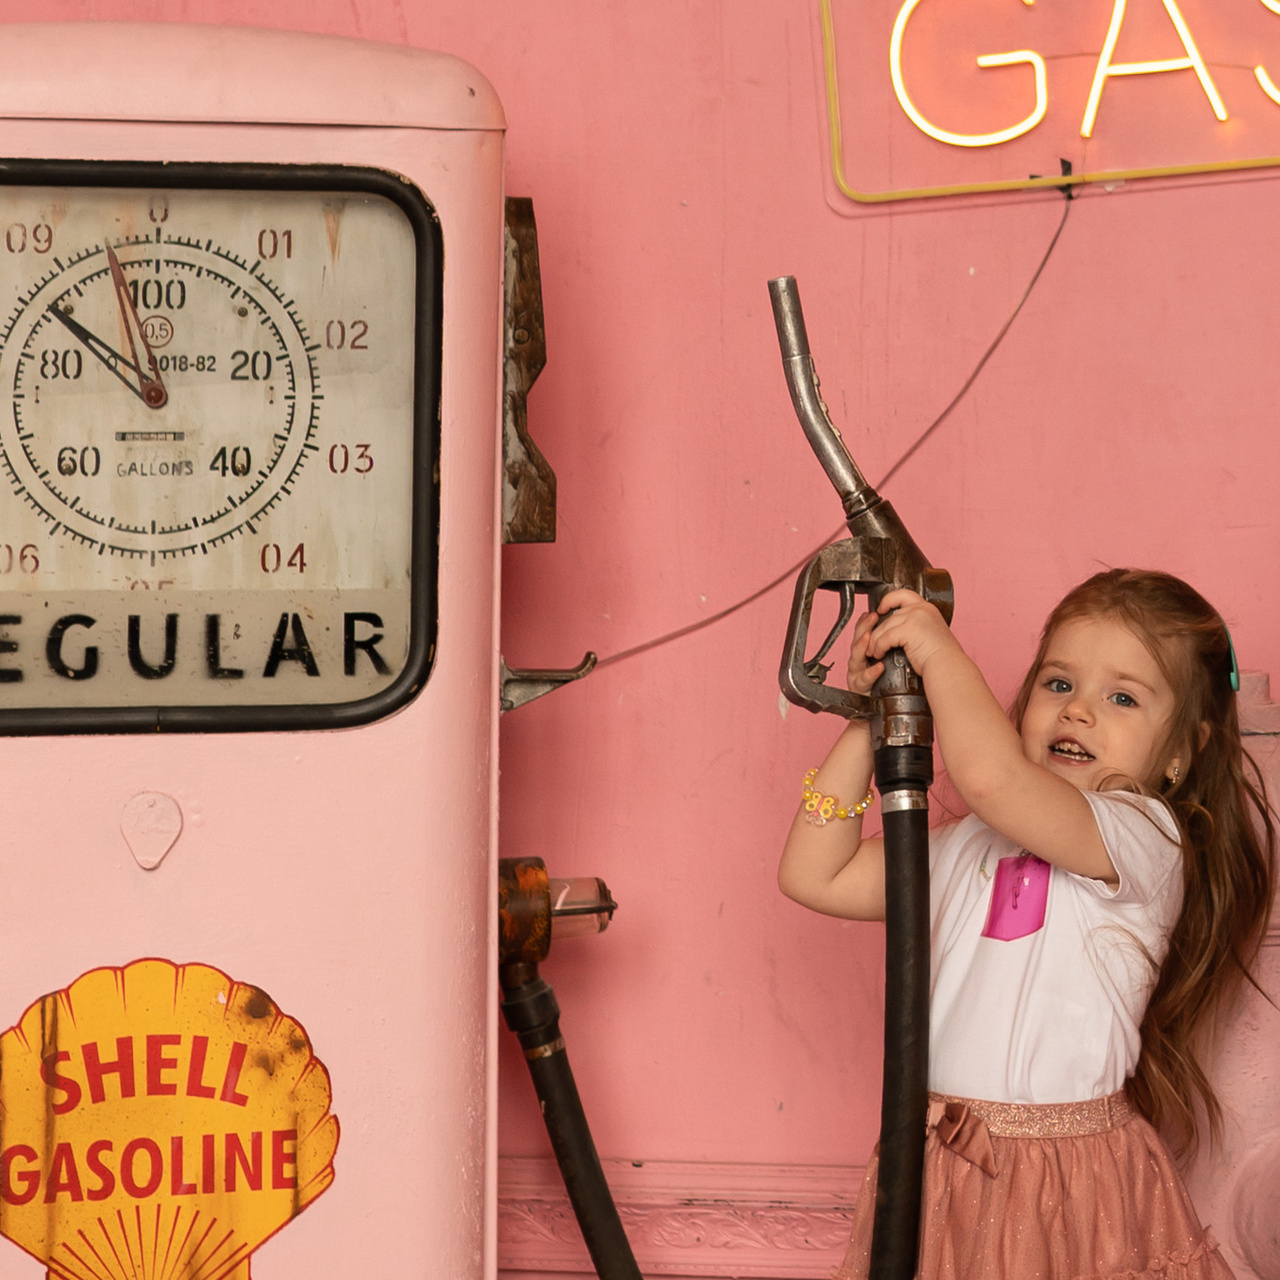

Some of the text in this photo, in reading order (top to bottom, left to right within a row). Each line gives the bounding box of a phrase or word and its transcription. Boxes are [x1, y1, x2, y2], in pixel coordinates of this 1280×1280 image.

[5, 223, 53, 254] 09
[257, 229, 294, 259] 01
[129, 279, 186, 310] 100
[326, 321, 369, 350] 02
[40, 349, 83, 379] 80
[230, 351, 272, 381] 20
[57, 446, 101, 477] 60
[117, 460, 194, 477] GALLONS
[209, 446, 252, 477] 40
[329, 443, 374, 475] 03
[260, 543, 307, 574] 04
[40, 1034, 249, 1116] SHELL
[0, 1129, 298, 1206] GASOLINE
